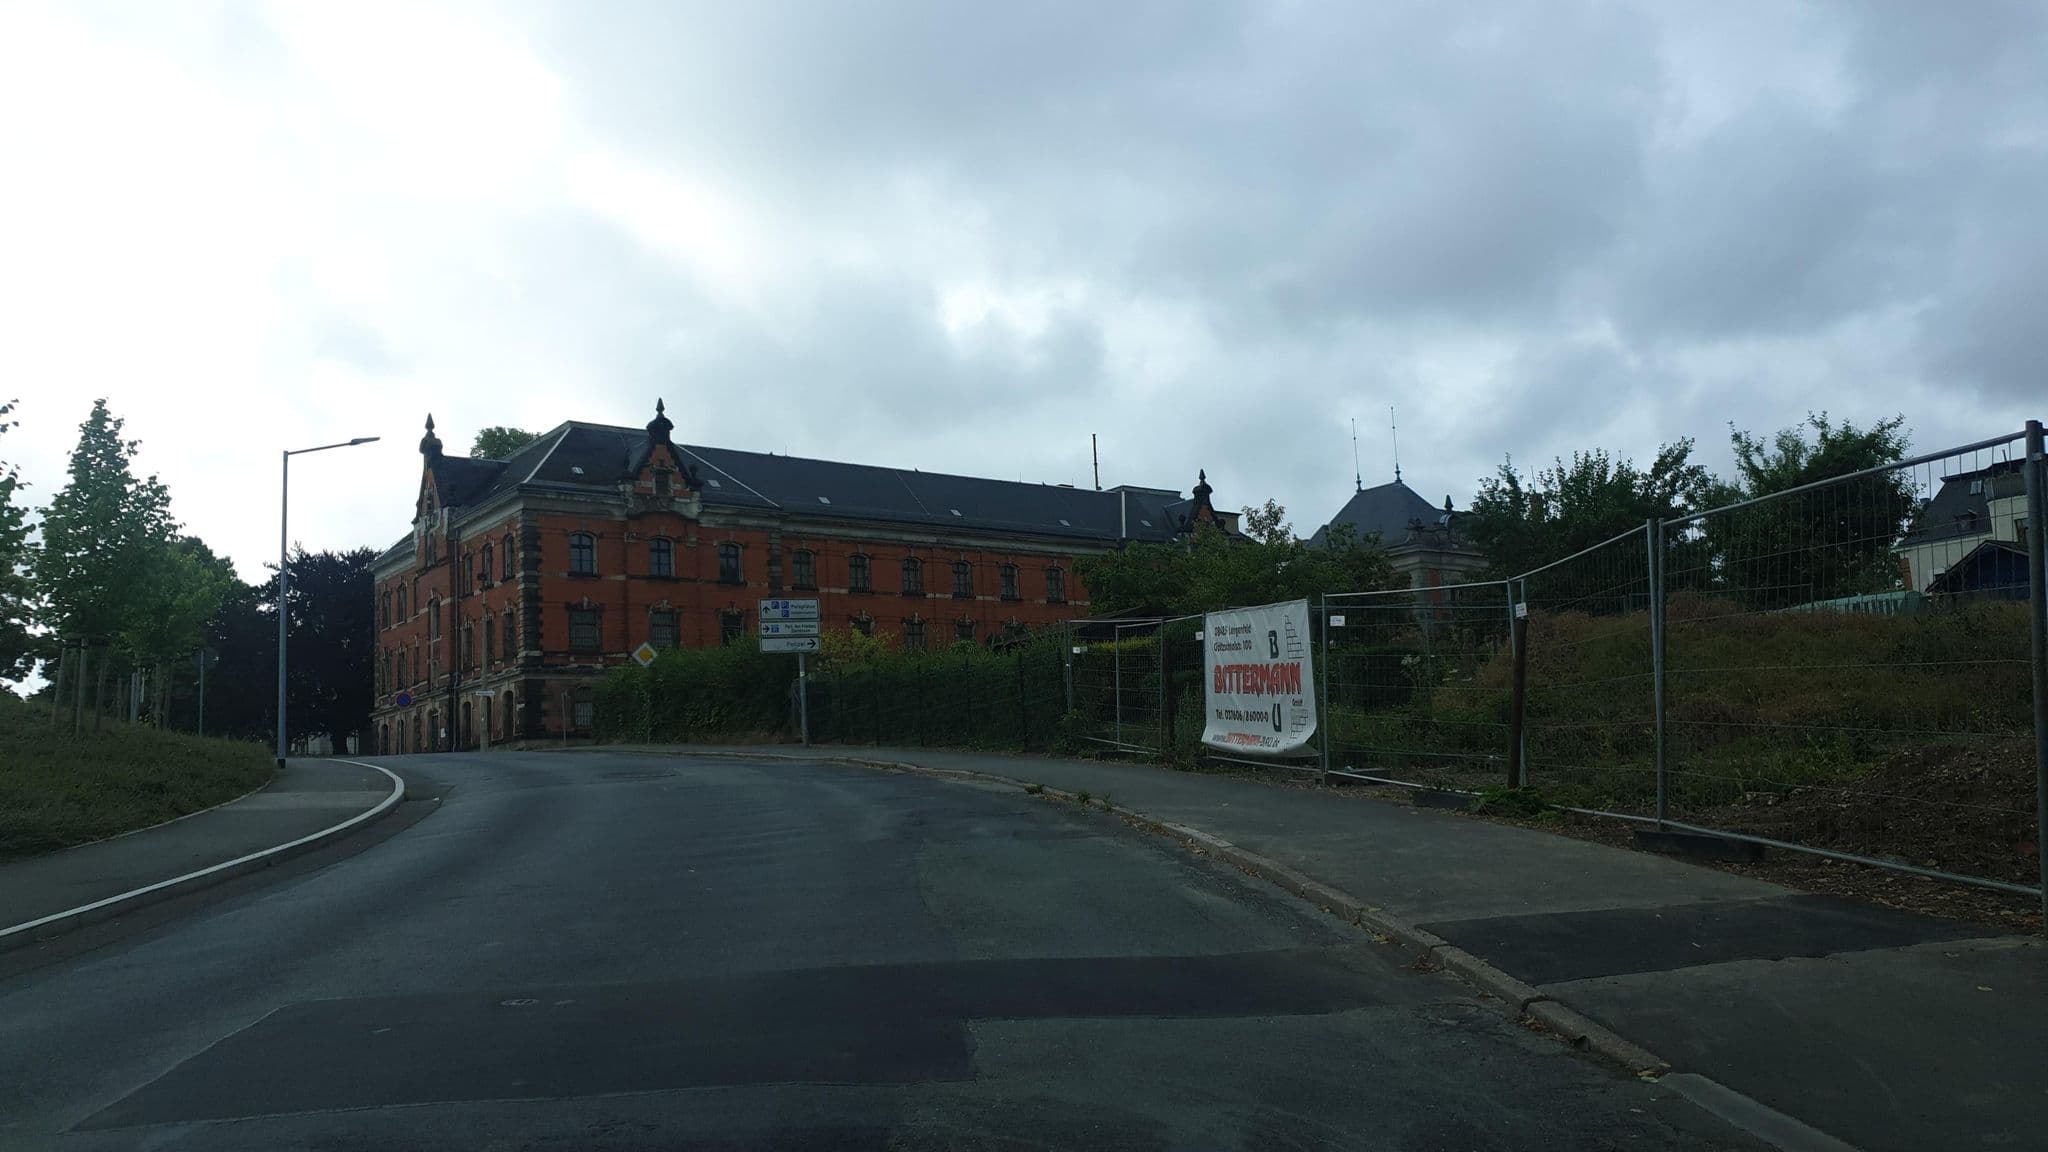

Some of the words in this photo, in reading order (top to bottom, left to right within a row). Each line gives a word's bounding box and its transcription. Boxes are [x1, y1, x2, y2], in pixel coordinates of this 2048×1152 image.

[1268, 630, 1280, 659] B
[1214, 662, 1302, 698] BITTERMANN
[1271, 703, 1282, 732] U
